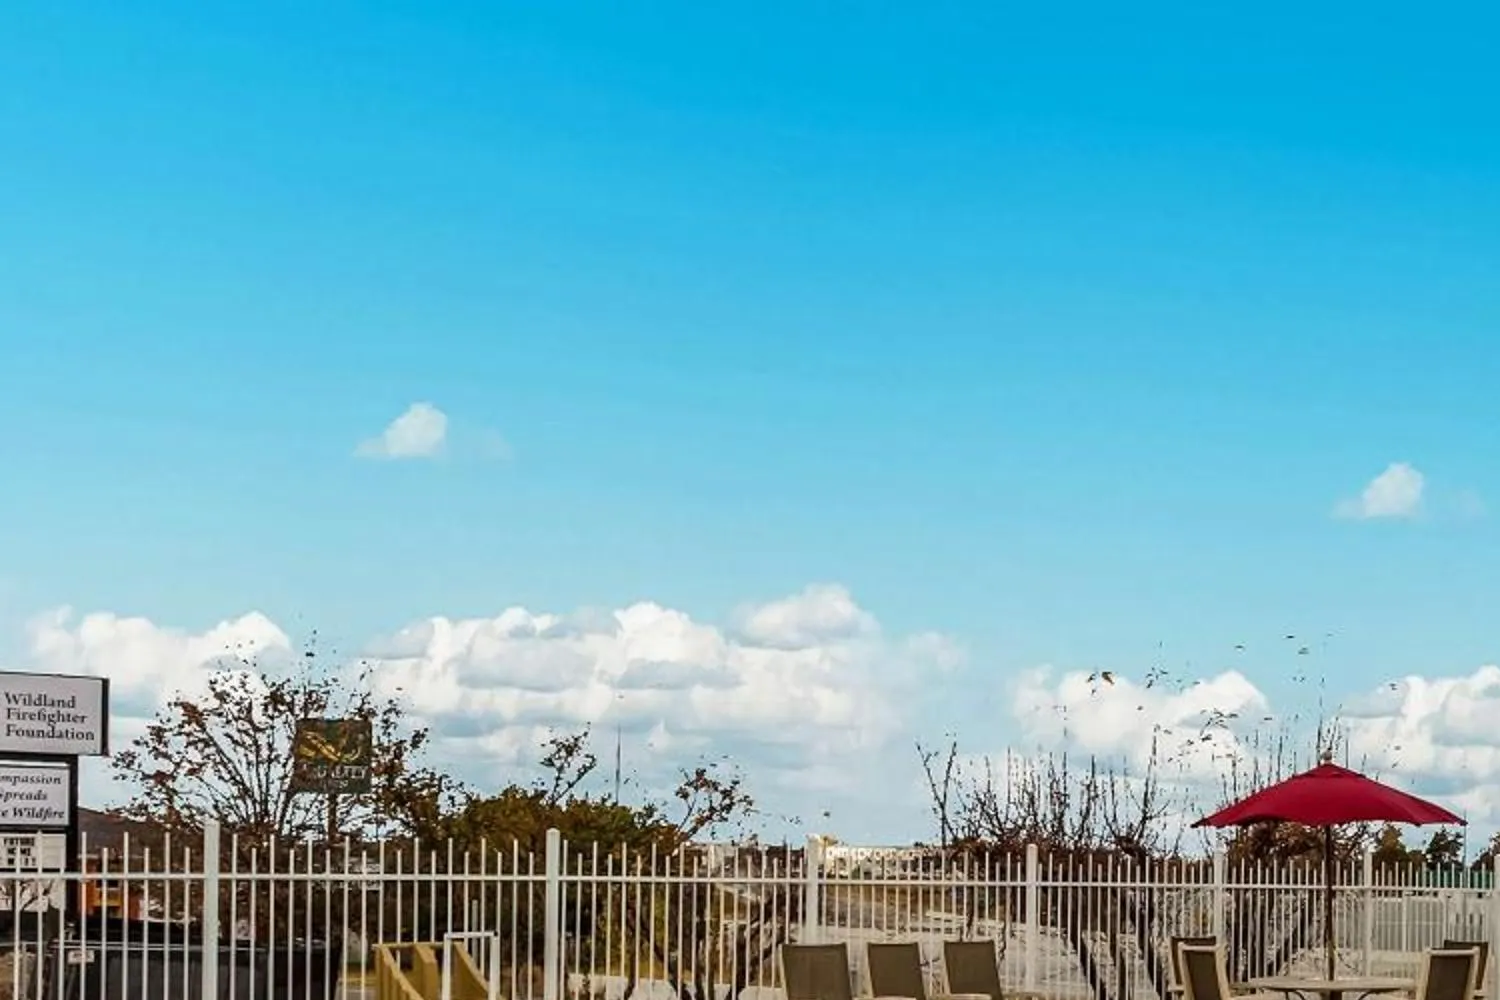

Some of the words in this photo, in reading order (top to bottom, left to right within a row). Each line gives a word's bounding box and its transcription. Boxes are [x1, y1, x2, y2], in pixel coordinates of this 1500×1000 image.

[4, 691, 76, 709] Wildland
[6, 708, 88, 728] Firefighter
[5, 723, 95, 741] Foundation
[0, 775, 62, 786] mpassion
[13, 807, 65, 821] Wildfire
